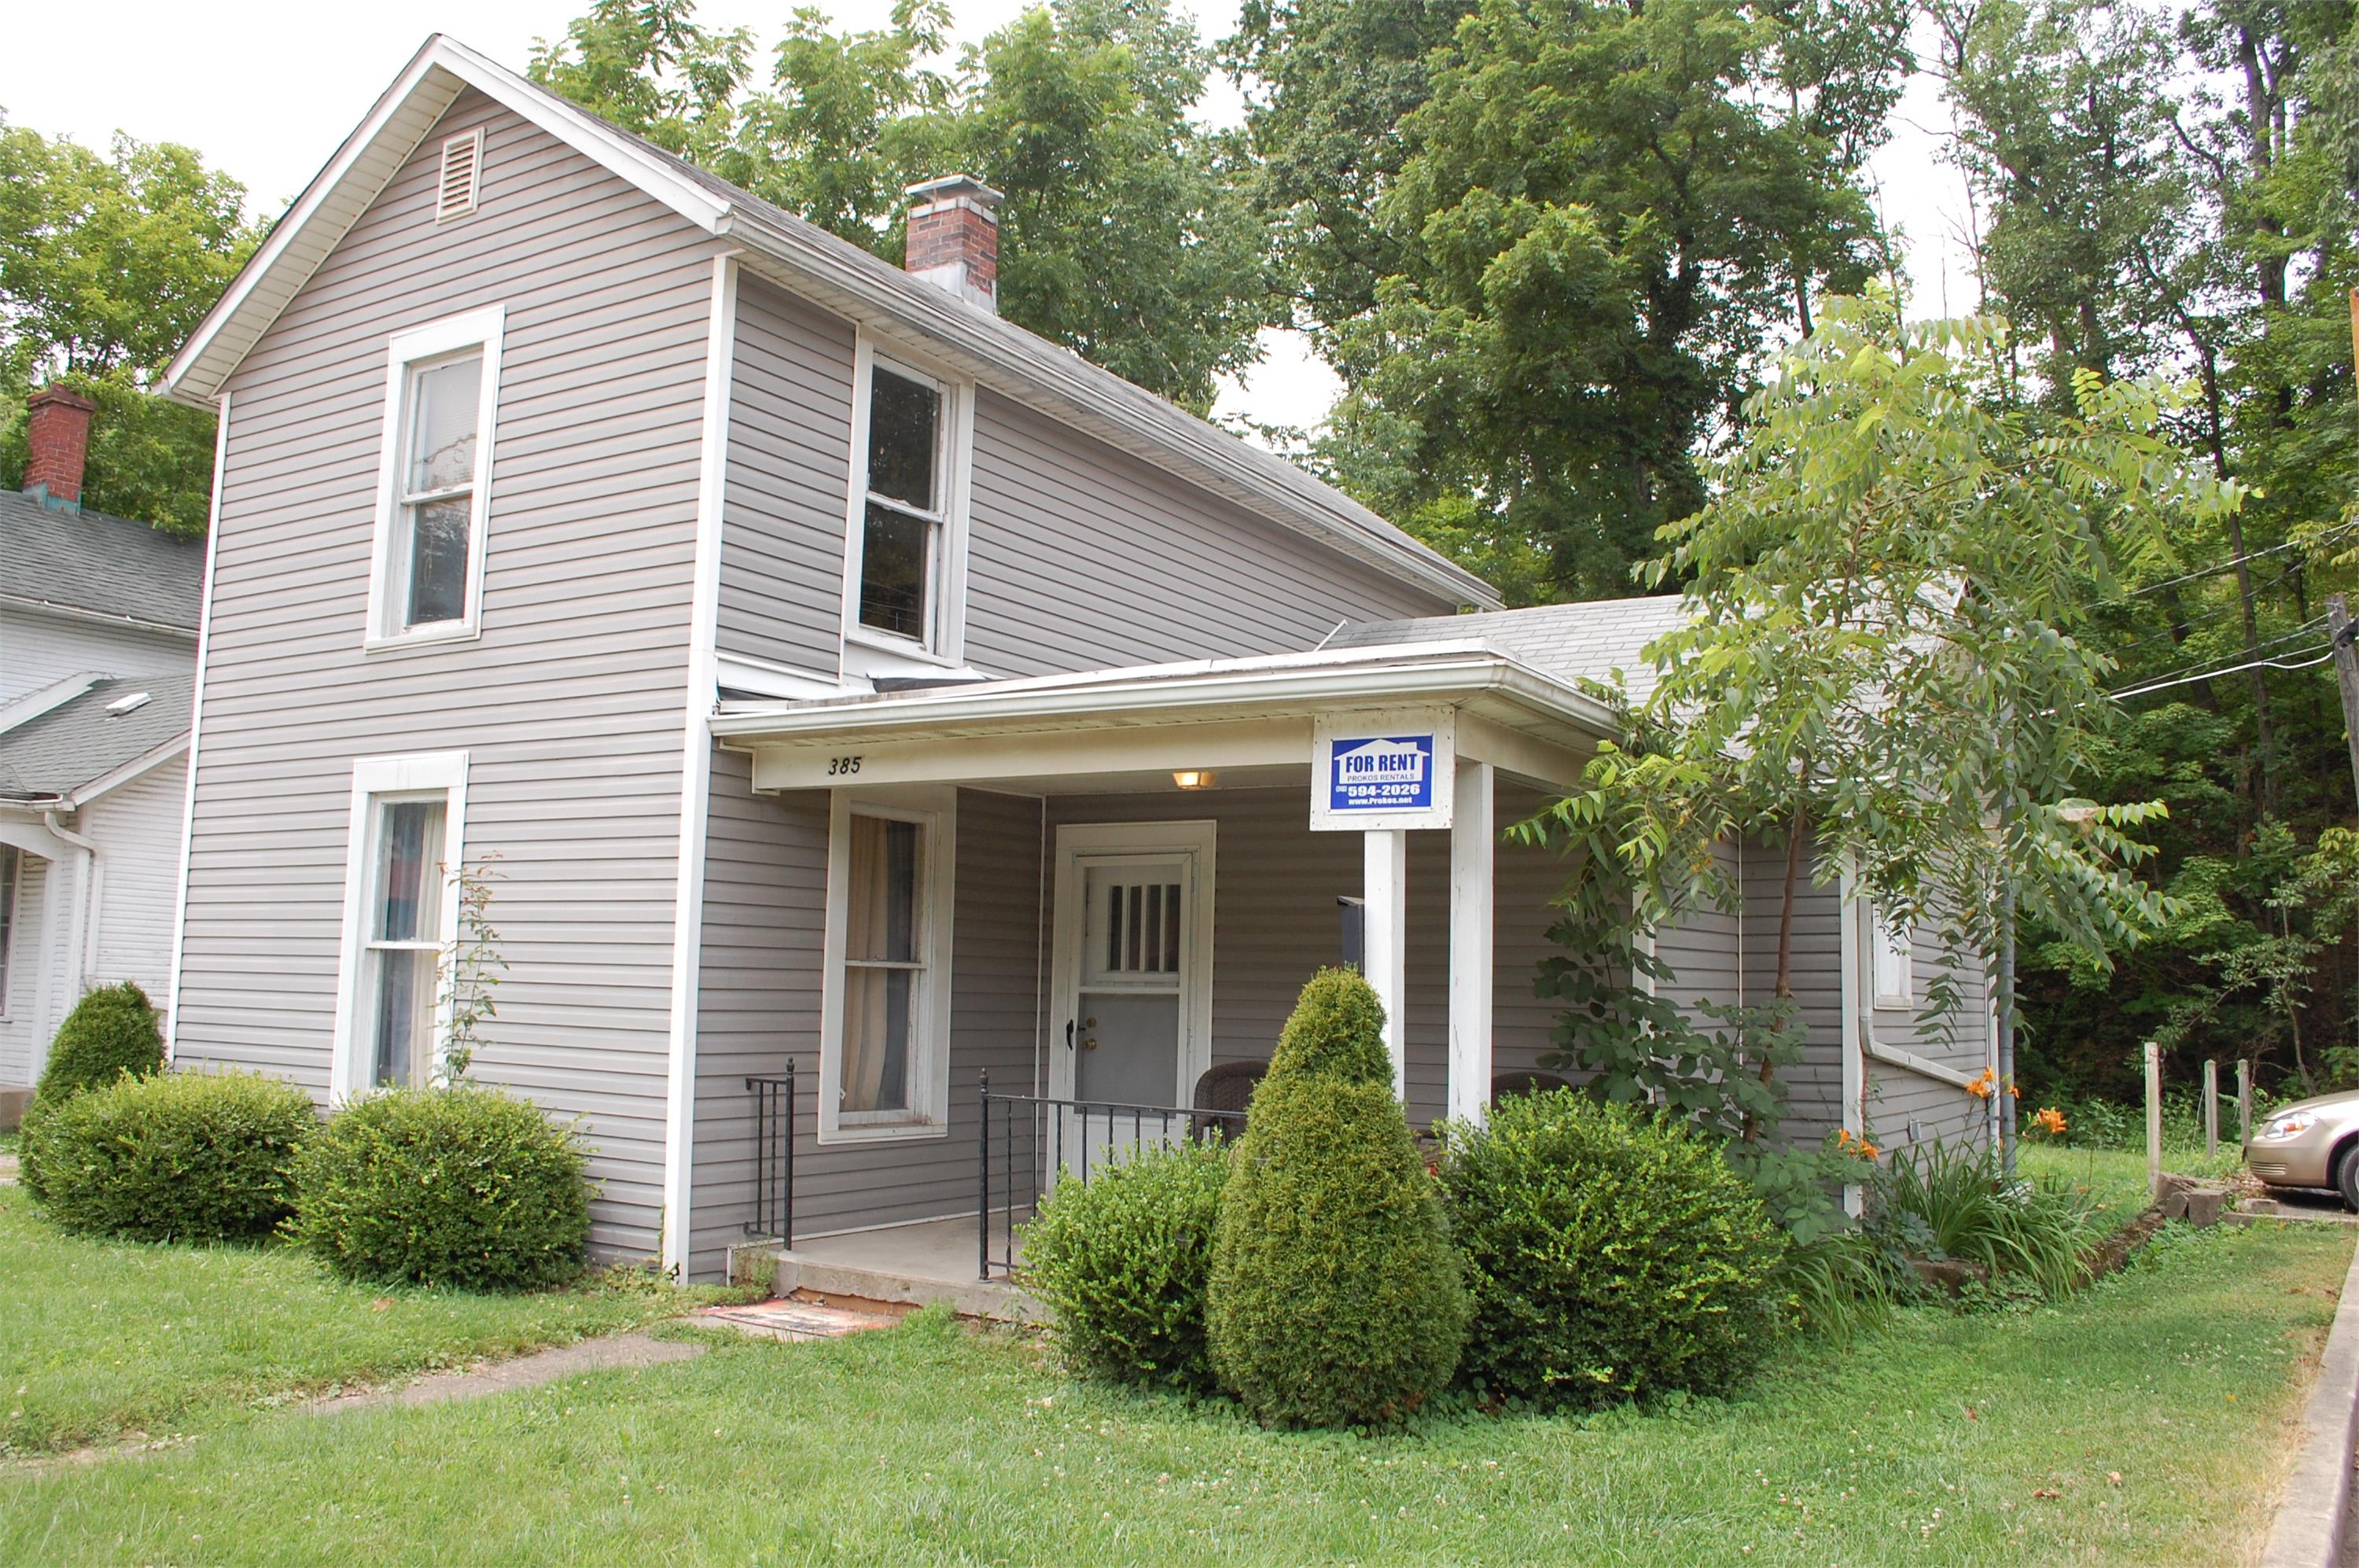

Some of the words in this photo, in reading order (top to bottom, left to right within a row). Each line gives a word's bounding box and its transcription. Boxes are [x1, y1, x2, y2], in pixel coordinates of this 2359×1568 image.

[828, 756, 862, 775] 385
[1346, 755, 1374, 773] FOR
[1378, 753, 1417, 771] RENT
[1347, 783, 1420, 797] 594-2026
